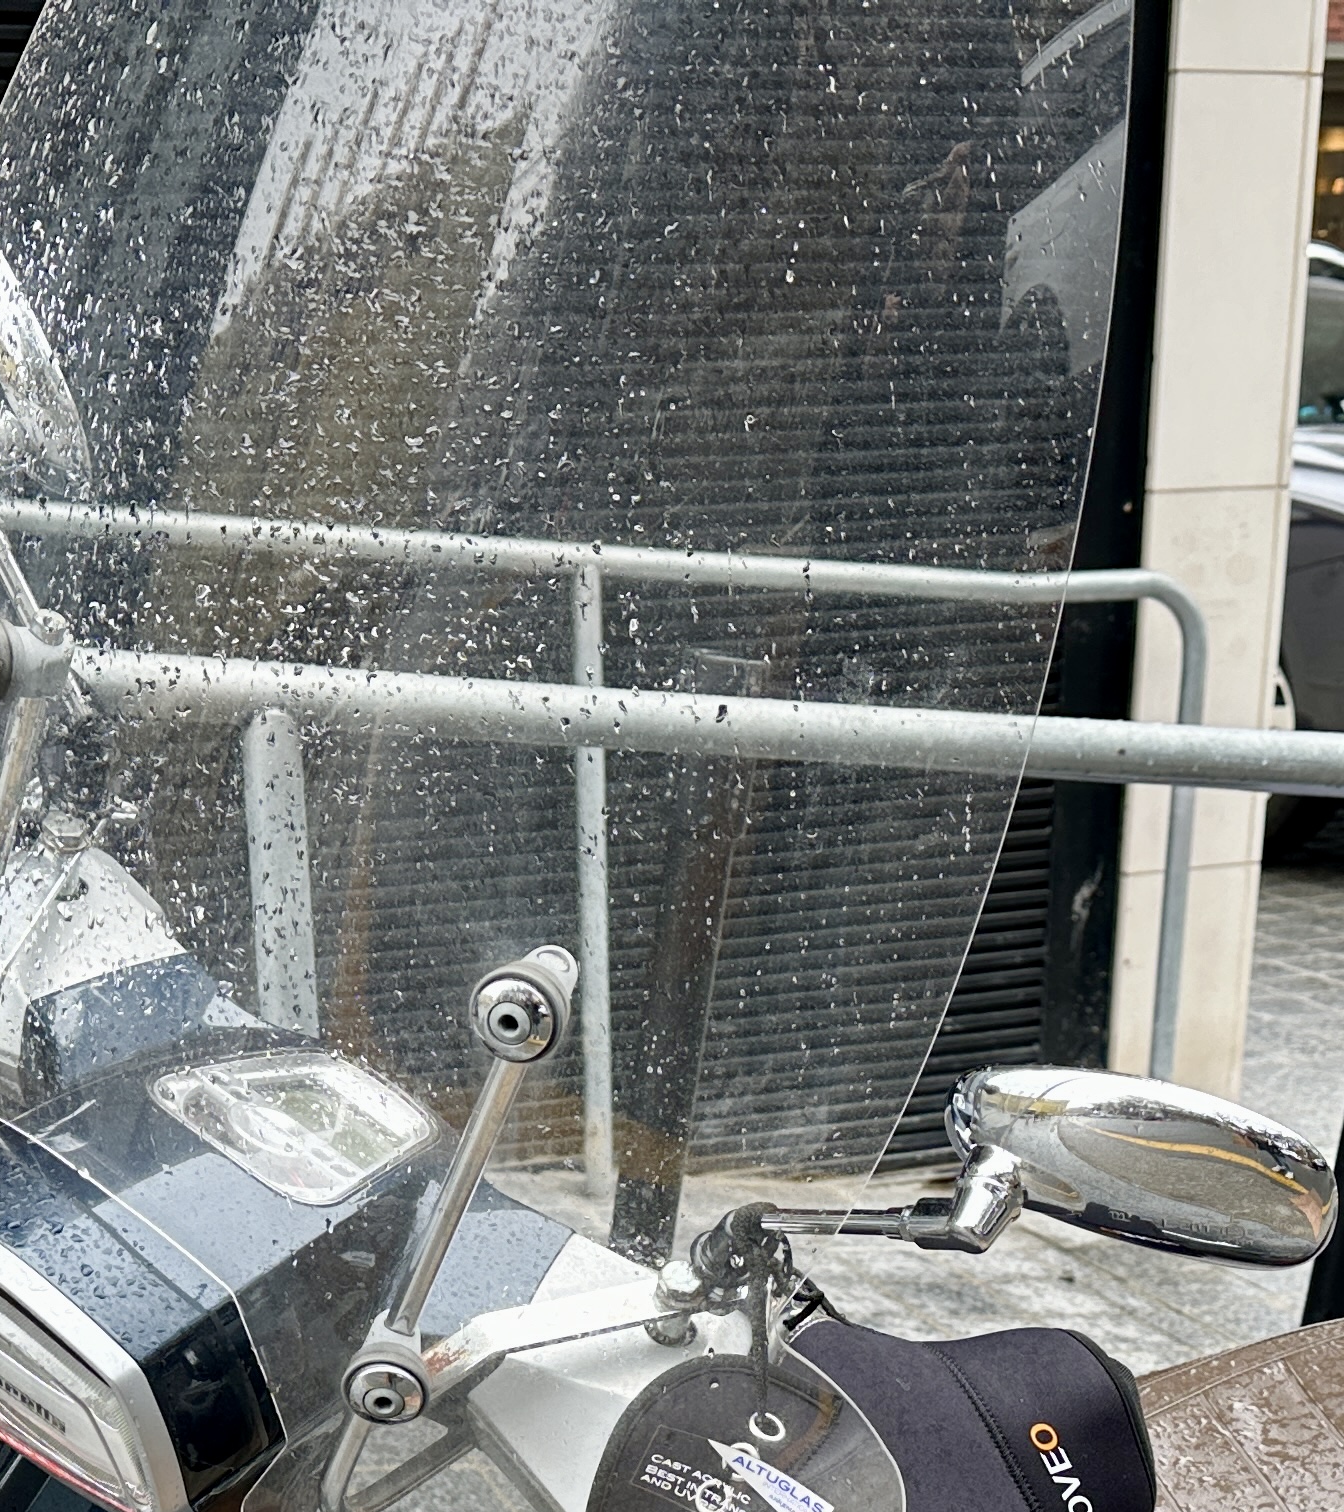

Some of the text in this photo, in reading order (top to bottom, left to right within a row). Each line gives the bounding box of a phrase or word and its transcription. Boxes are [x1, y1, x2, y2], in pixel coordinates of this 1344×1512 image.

[639, 1473, 673, 1491] AND
[673, 1485, 699, 1502] UV
[644, 1463, 686, 1485] BEST
[685, 1480, 701, 1496] IN
[650, 1453, 752, 1505] CAST ACRYLIC
